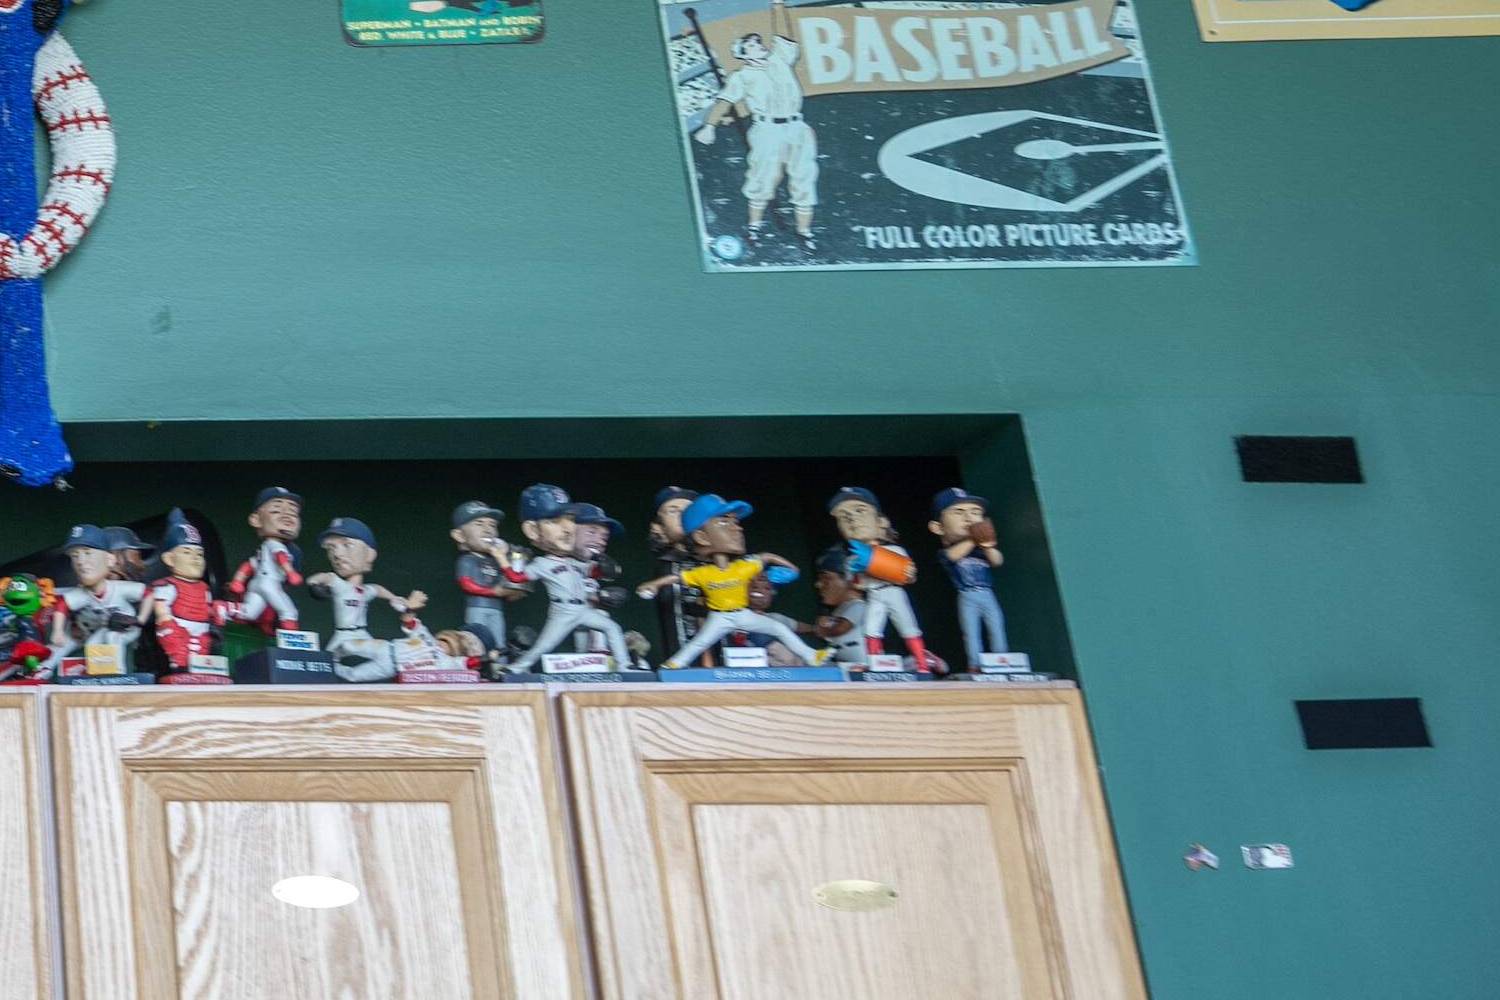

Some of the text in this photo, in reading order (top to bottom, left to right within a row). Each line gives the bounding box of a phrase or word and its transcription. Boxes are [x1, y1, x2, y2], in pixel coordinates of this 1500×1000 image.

[346, 20, 411, 30] SUPERMAN
[423, 18, 476, 27] BATMAN
[386, 30, 425, 40] WHITE
[437, 29, 467, 39] BLUE
[798, 4, 1111, 86] BASEBALL
[862, 221, 1176, 249] FULL COLOR PICTURE CARDS
